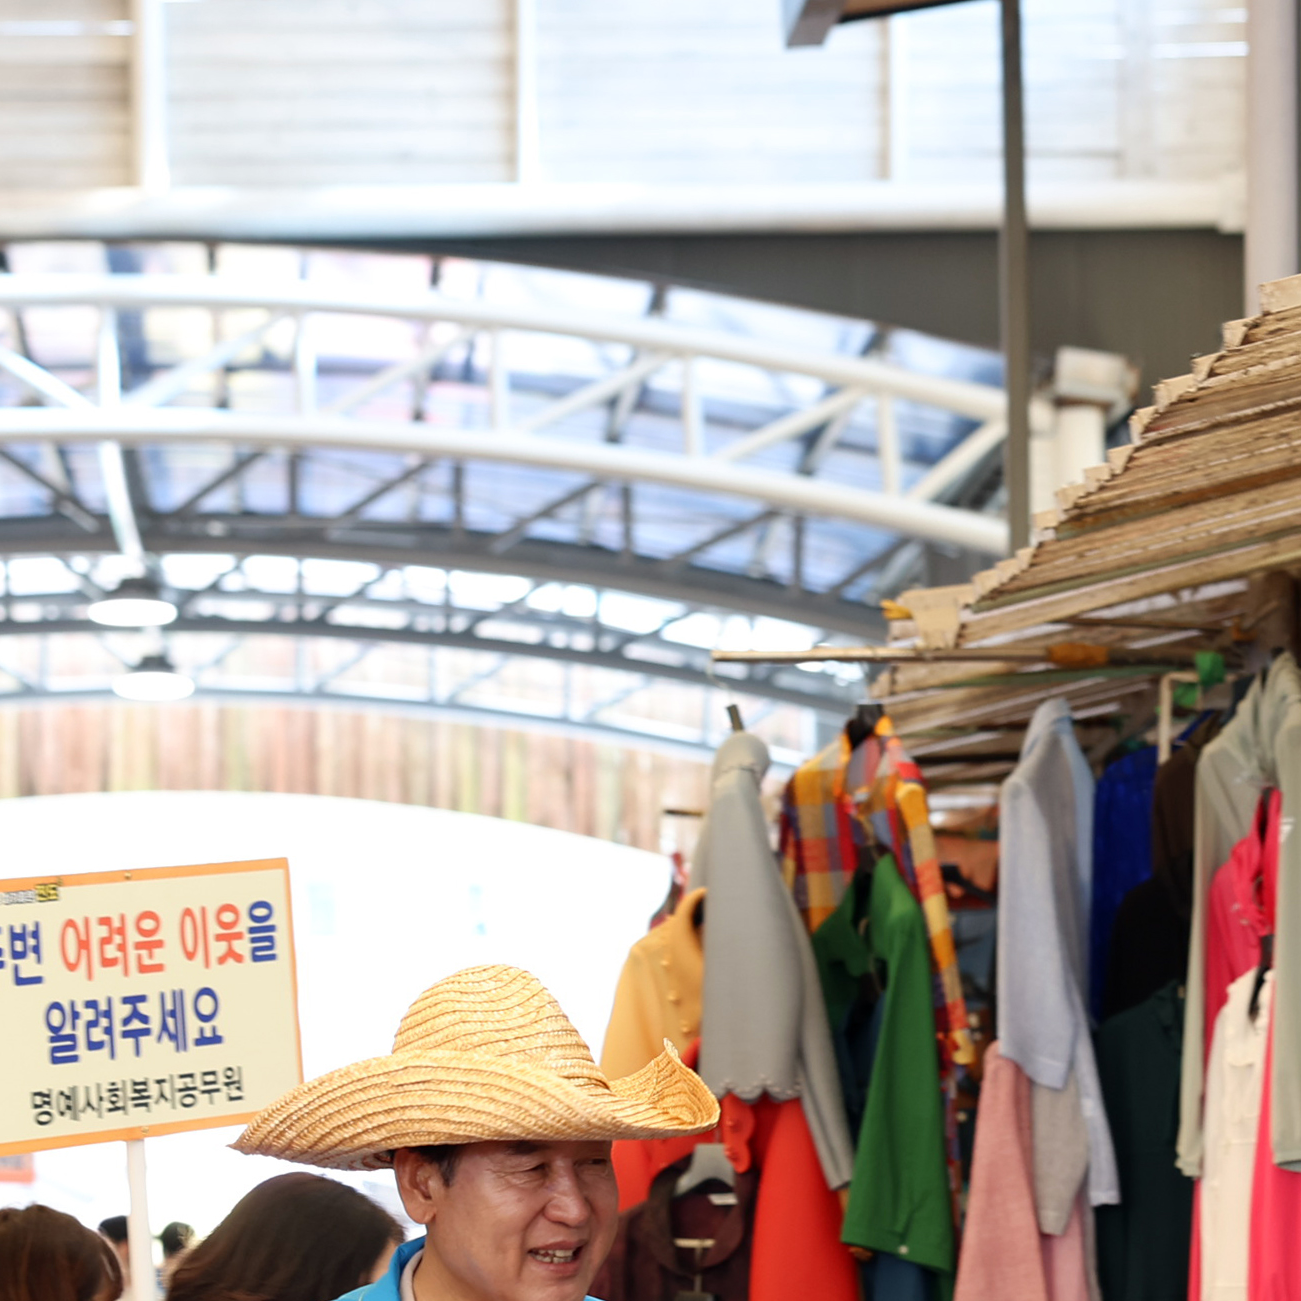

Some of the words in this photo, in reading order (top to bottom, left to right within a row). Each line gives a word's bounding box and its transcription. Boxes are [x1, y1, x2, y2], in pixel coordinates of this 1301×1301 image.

[59, 909, 165, 982] 어려운
[179, 900, 278, 970] 이웃을
[45, 987, 224, 1065] 알려주세요
[32, 1066, 245, 1126] 명예사회복지공무원
